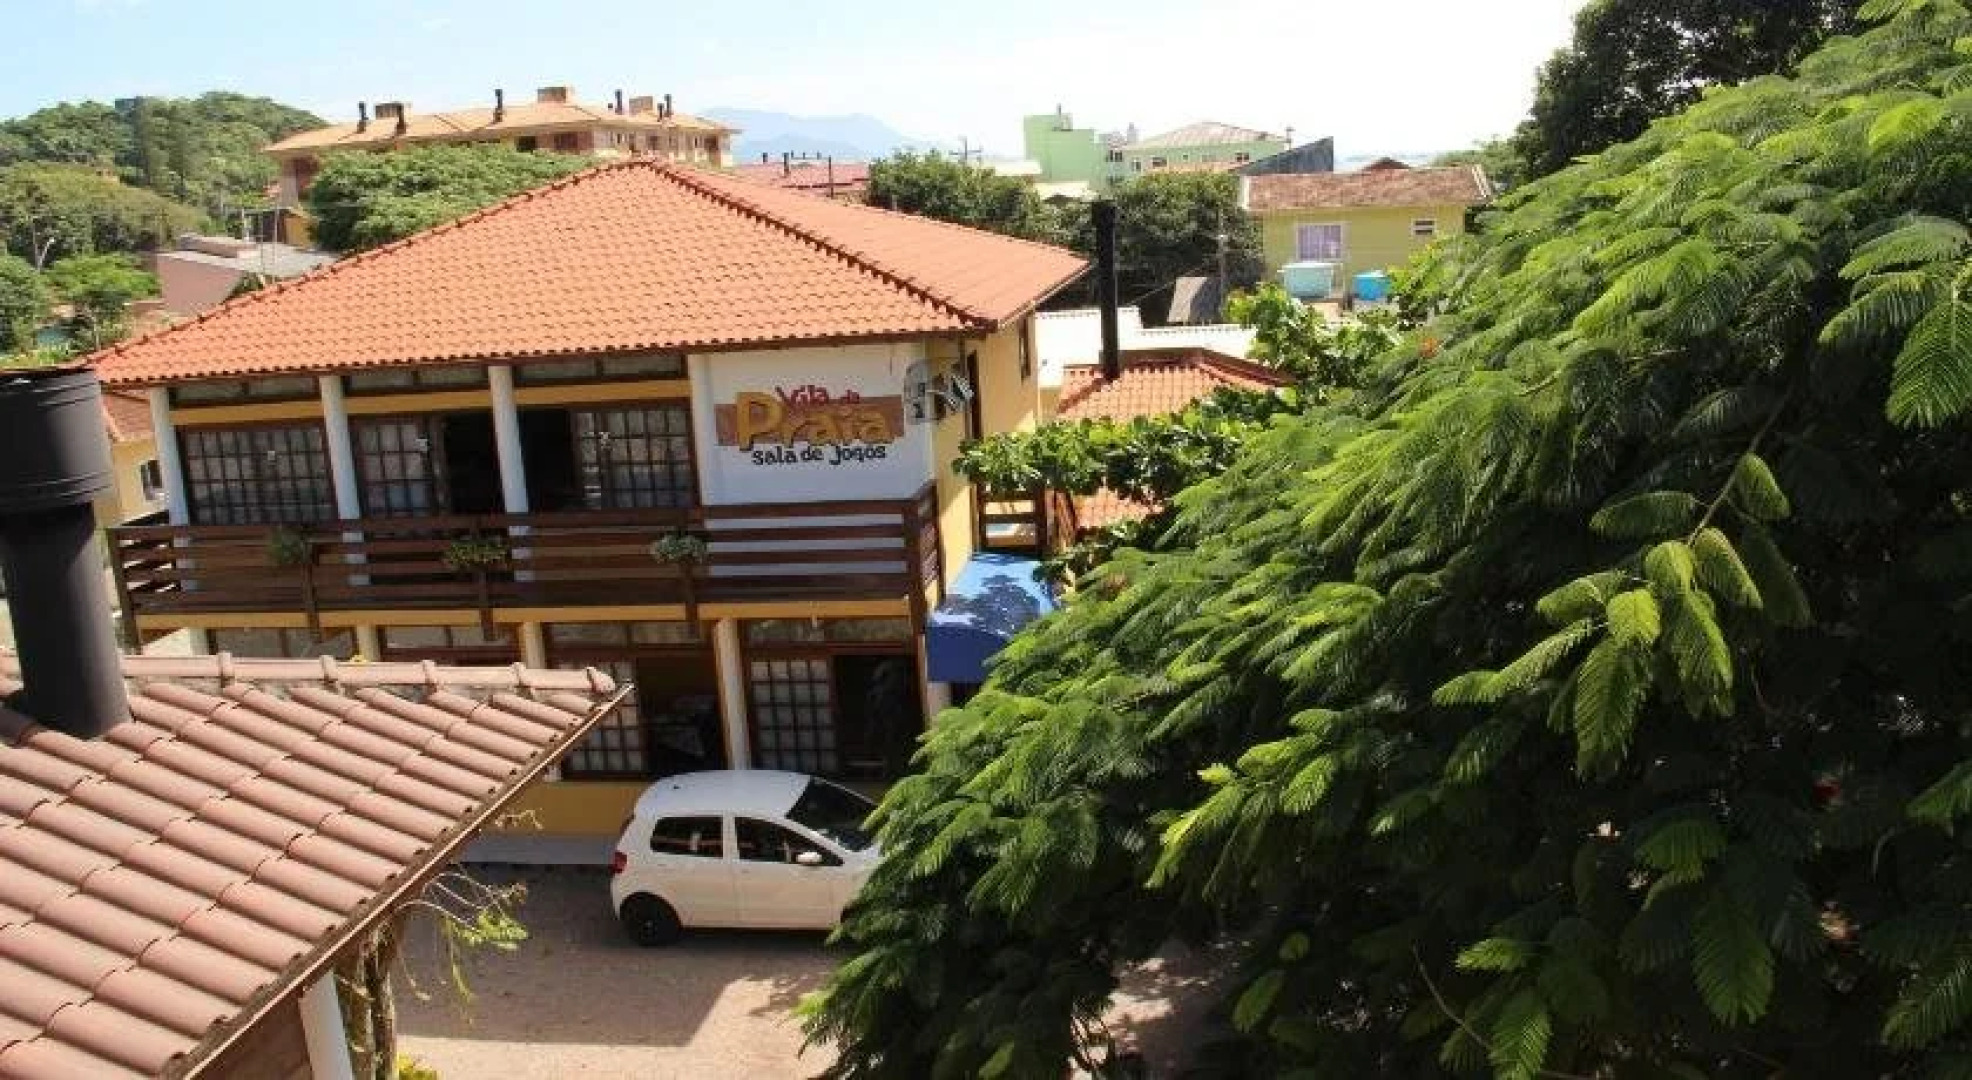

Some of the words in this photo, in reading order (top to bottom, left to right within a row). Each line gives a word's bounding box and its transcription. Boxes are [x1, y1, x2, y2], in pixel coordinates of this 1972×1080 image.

[773, 384, 829, 407] Vila
[840, 389, 859, 405] da
[735, 391, 889, 452] Praia
[800, 448, 824, 463] de
